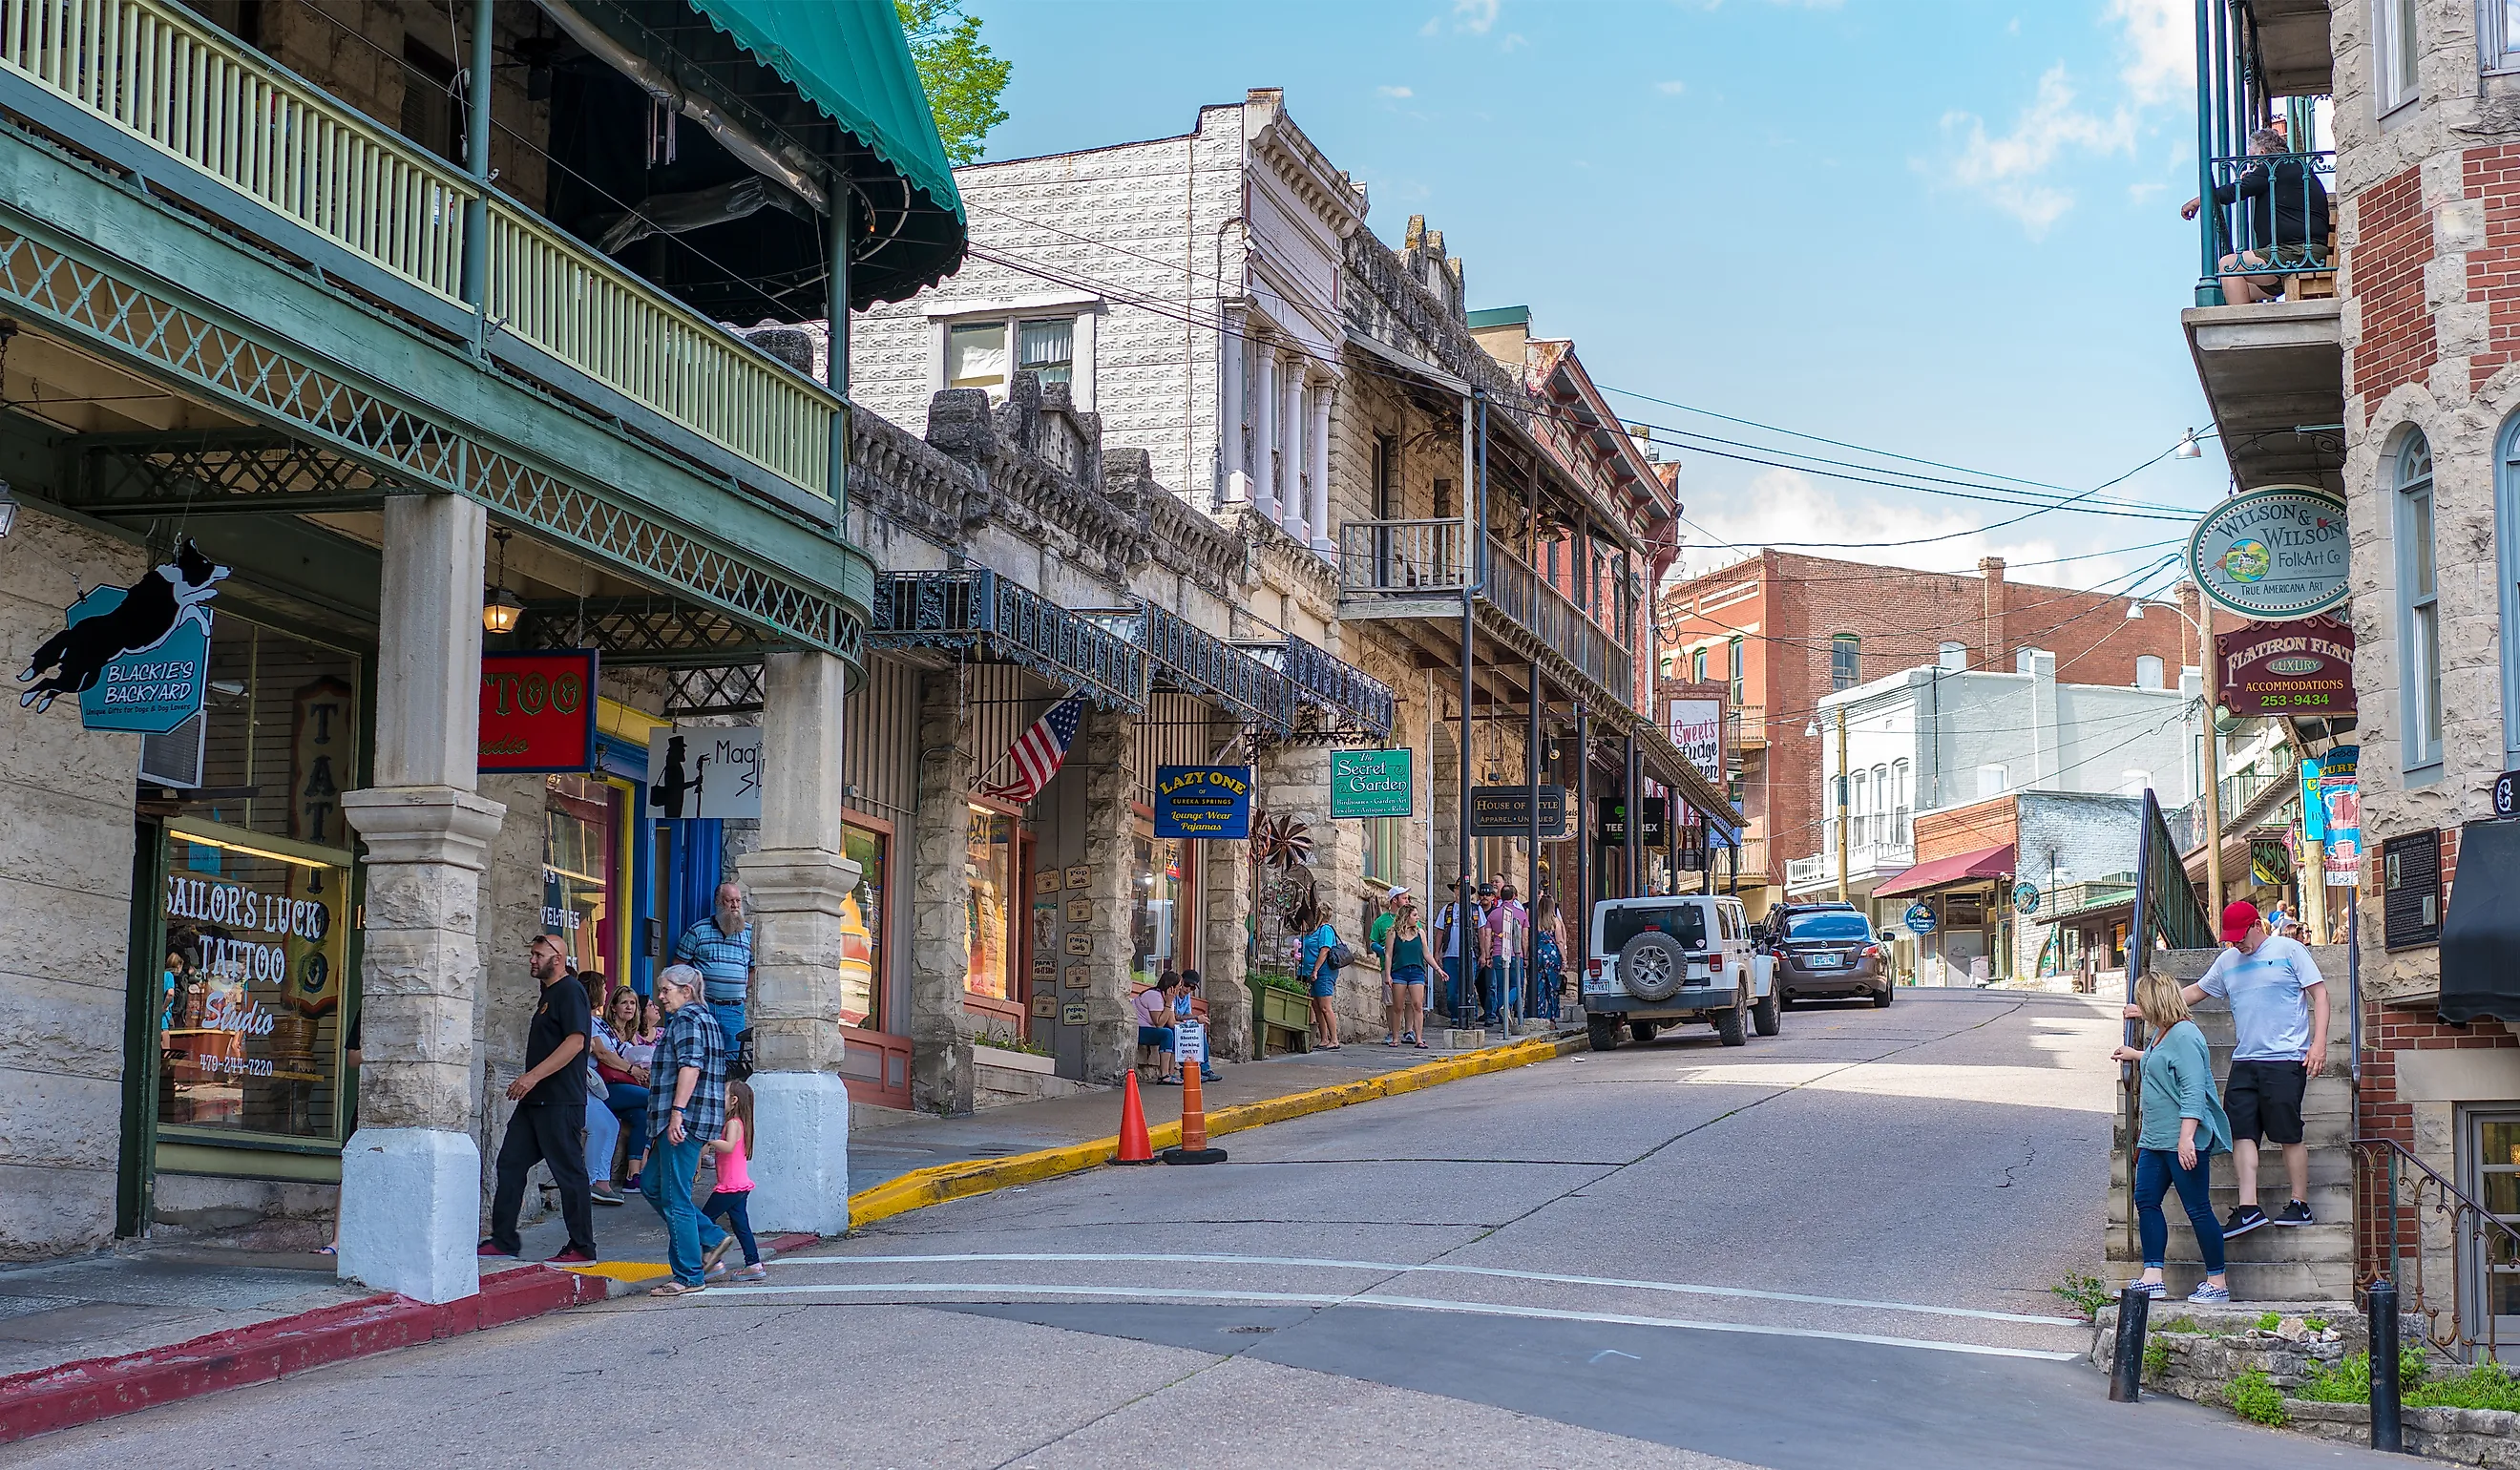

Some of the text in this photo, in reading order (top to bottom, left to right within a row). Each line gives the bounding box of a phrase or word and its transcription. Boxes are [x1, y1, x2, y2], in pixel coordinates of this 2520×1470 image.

[2216, 504, 2312, 539] WILSON &
[2260, 522, 2343, 549] WILSON
[2278, 551, 2325, 568] FolkArt
[2241, 581, 2323, 596] TRUE AMERICANA ART
[107, 661, 195, 683] BLACKIE'S
[2226, 637, 2354, 687] FLATIRON FLAT
[2271, 660, 2319, 671] LUXURY
[104, 682, 193, 704] BACKYARD
[481, 671, 583, 716] TOO
[2245, 680, 2344, 692] ACCOMMODATIONS
[158, 704, 168, 713] Dog
[2260, 694, 2330, 706] 253-9434
[1674, 718, 1715, 745] Sweet's
[478, 733, 529, 755] udio
[1336, 759, 1386, 777] Secret
[1359, 753, 1375, 762] The
[2319, 763, 2356, 777] EURE
[1159, 771, 1247, 795] LAZY ONE
[1350, 776, 1407, 796] Garden
[1374, 796, 1396, 805] Garden
[1476, 800, 1510, 810] HOUSE
[1538, 801, 1559, 809] TYLE
[1171, 810, 1232, 821] Lounge Wear
[1181, 822, 1222, 832] Pajamas
[1605, 823, 1624, 832] TEE
[2253, 841, 2287, 884] OASIS
[263, 894, 321, 938] LUCK
[540, 906, 580, 930] VELTIES
[199, 934, 285, 984] TATTOO
[201, 991, 275, 1036] Studio
[200, 1053, 273, 1077] 479-244-7220
